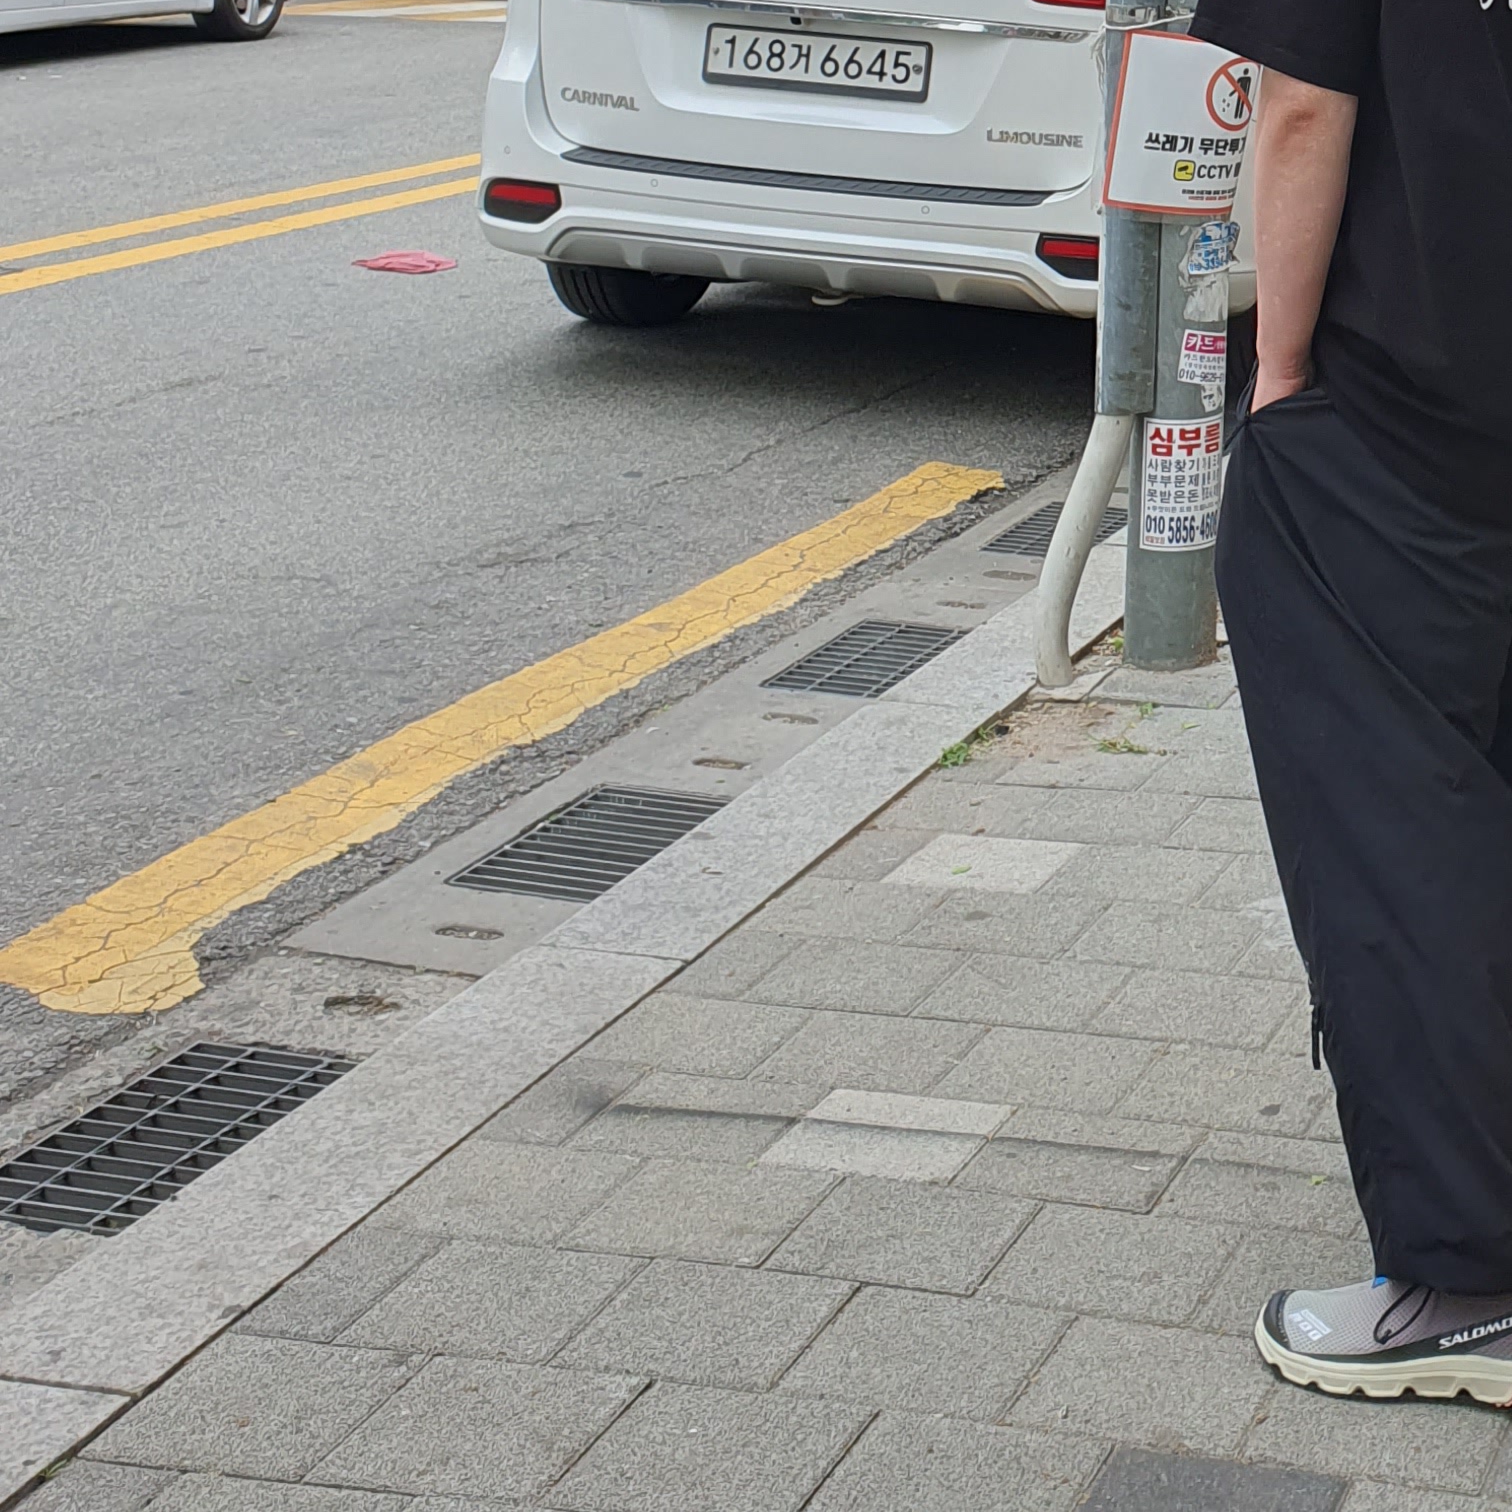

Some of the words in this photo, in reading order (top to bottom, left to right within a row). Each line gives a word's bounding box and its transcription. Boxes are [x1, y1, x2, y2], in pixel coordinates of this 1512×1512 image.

[560, 86, 640, 112] CARNIVAL
[985, 128, 1084, 149] LIMOUSINE
[1144, 131, 1195, 155] 쓰레기
[1196, 163, 1234, 180] CCTV
[1186, 335, 1215, 353] 카드
[1148, 422, 1221, 458] 심부름
[1147, 457, 1200, 474] 사람찾기
[1147, 473, 1200, 490] 부부문제
[1145, 514, 1166, 536] 010
